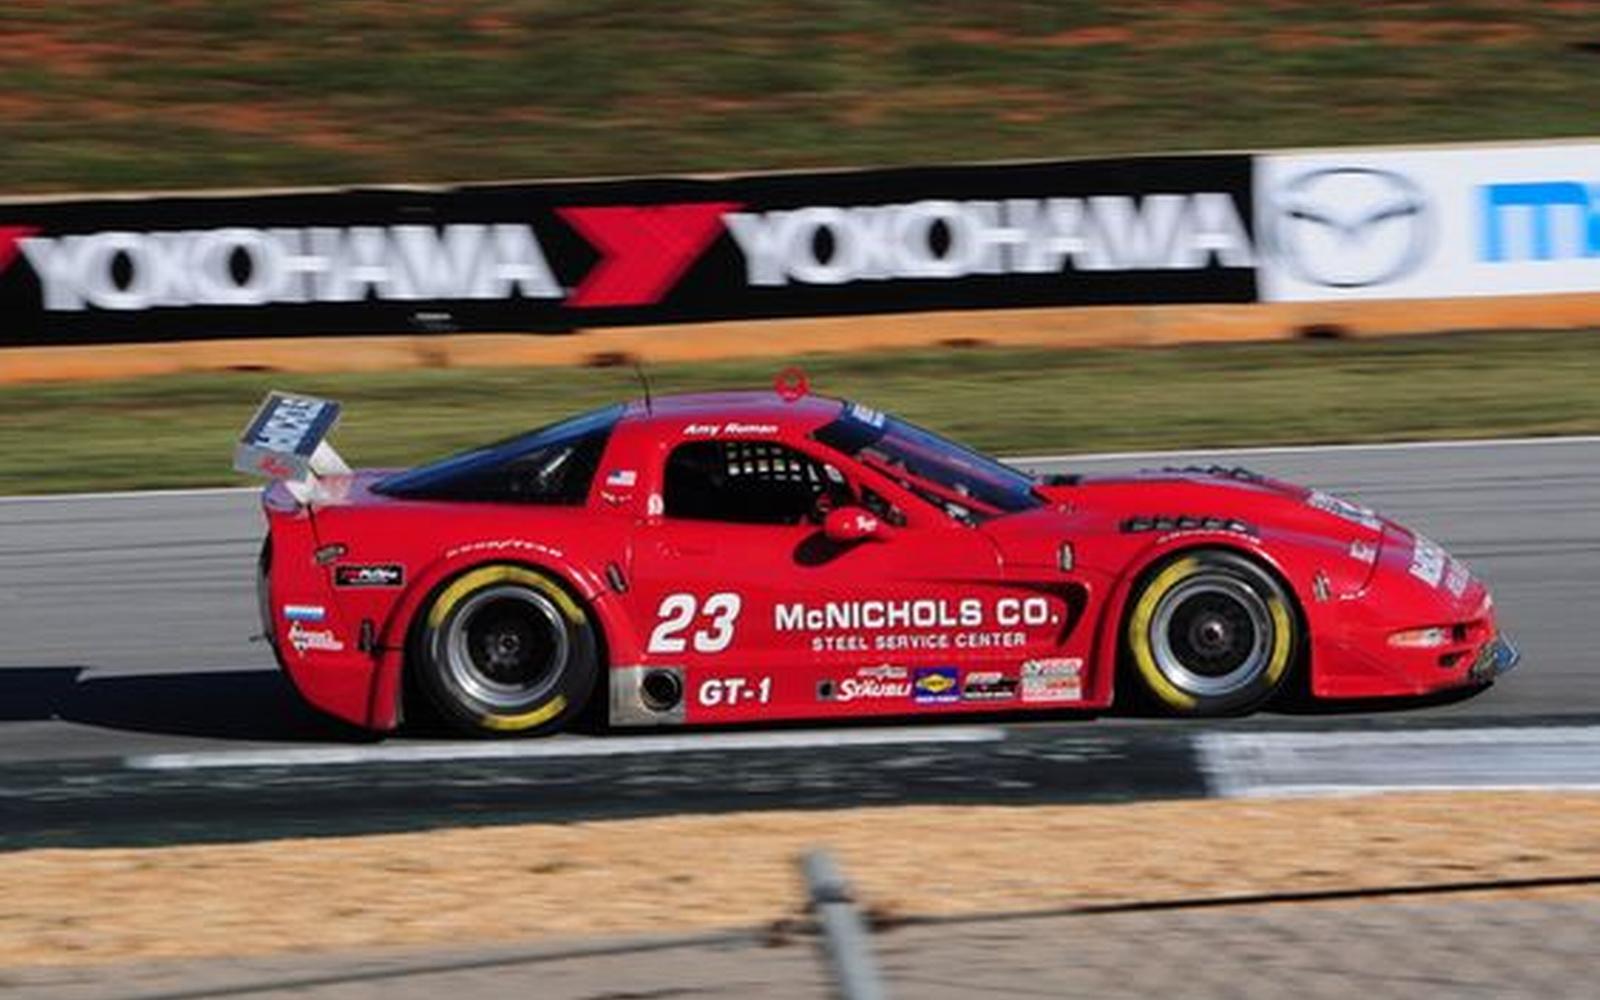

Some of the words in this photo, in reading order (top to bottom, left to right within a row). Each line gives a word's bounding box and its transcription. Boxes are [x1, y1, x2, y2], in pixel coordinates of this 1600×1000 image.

[722, 193, 1256, 287] YOKOHAMA
[14, 223, 566, 312] YOKOHAMA
[647, 592, 741, 653] 23
[775, 599, 982, 630] McNICHOLS
[996, 597, 1059, 626] CO.
[811, 636, 868, 652] STEEL
[874, 634, 948, 650] SERVICE
[955, 632, 1026, 648] CENTER
[698, 677, 771, 707] GT-1
